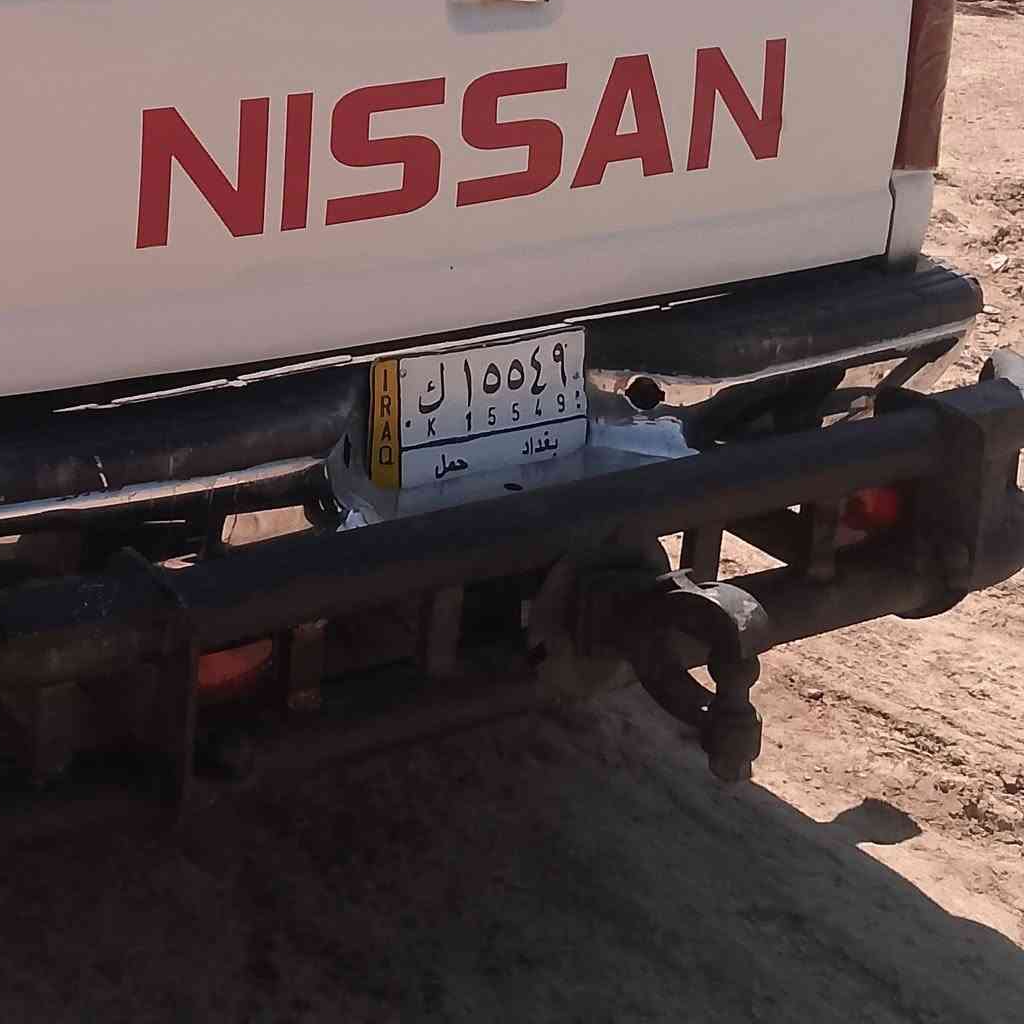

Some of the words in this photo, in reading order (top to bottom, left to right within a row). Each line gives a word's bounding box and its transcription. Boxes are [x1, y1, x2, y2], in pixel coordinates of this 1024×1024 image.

[135, 37, 787, 249] NISSAN
[378, 368, 394, 465] IRAQ
[522, 430, 558, 456] بغداد
